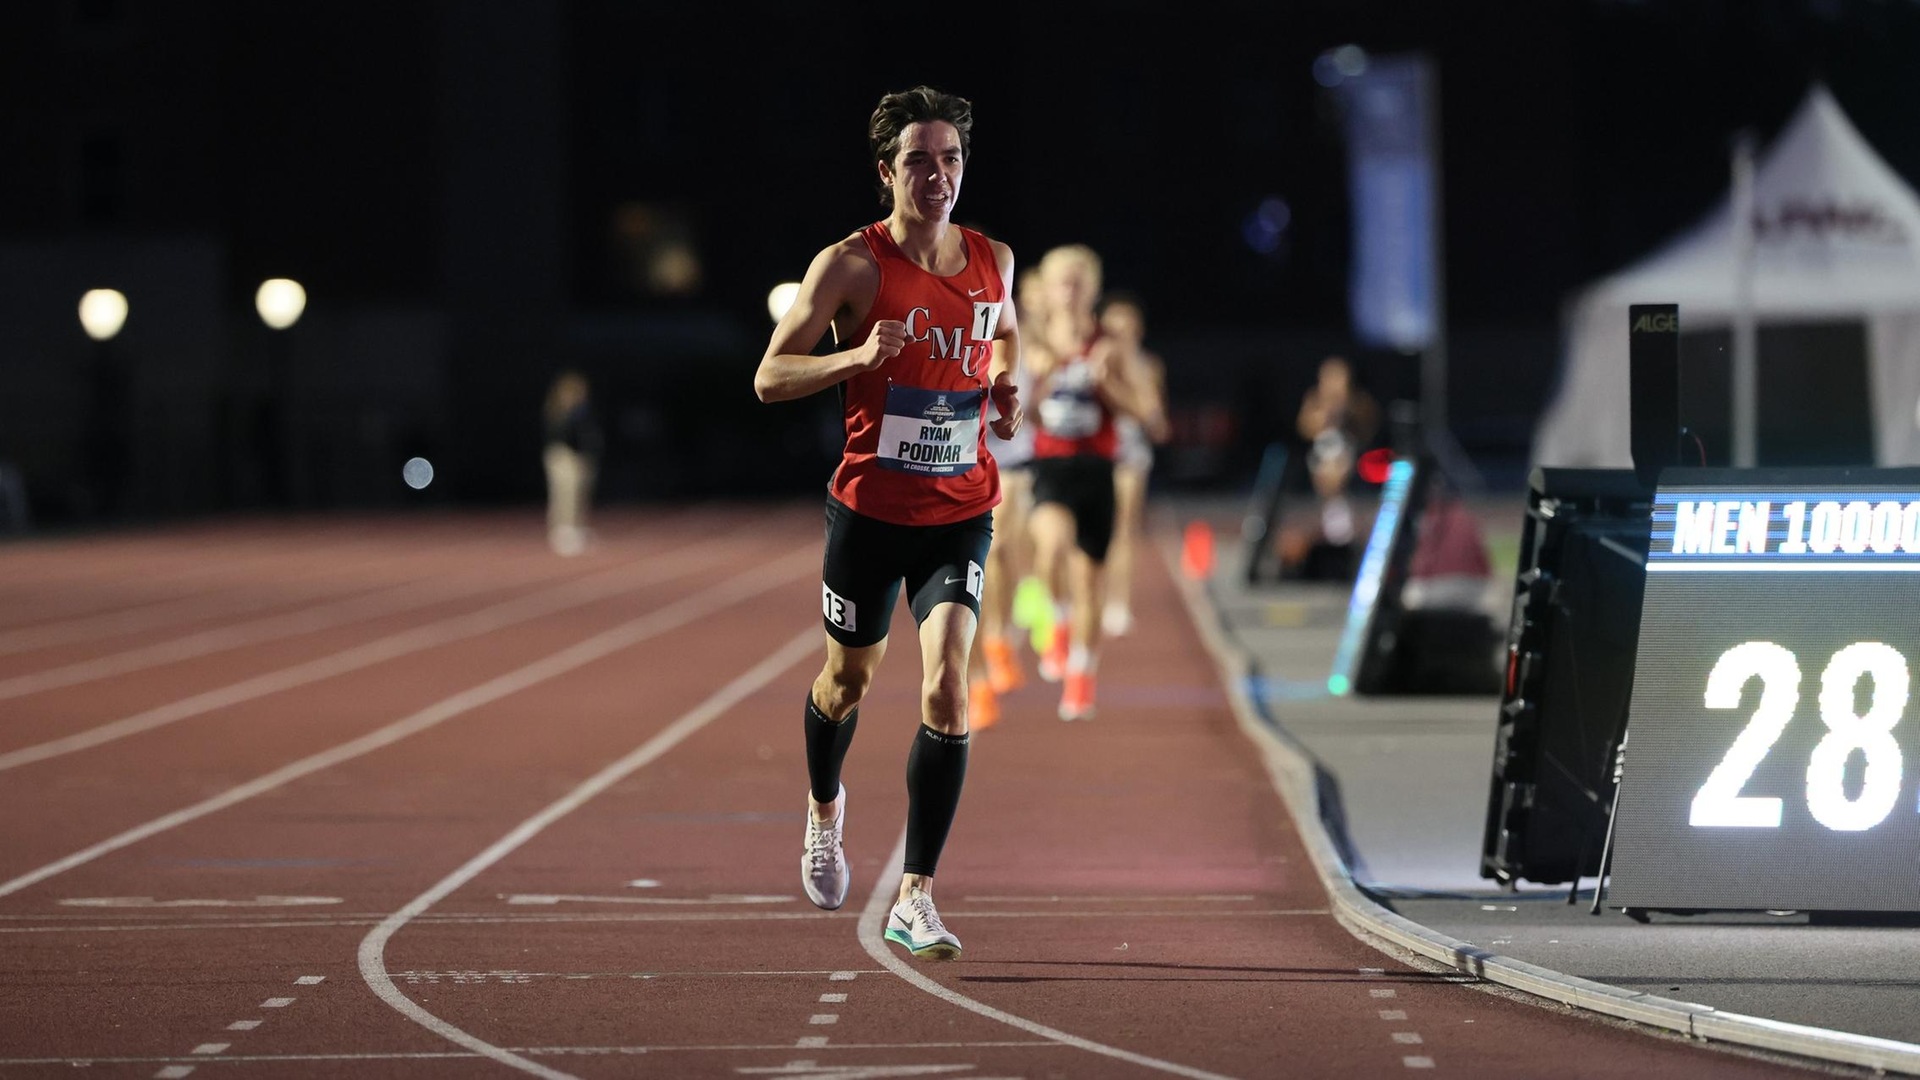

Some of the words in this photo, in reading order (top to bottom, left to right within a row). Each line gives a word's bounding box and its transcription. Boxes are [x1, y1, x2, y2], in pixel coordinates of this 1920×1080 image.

[1633, 314, 1677, 333] ALGE
[906, 307, 985, 377] CMU
[919, 426, 952, 442] RYAN
[897, 441, 961, 463] PODNAR
[1672, 500, 1770, 554] MEN
[825, 592, 847, 627] 13
[1689, 641, 1910, 831] 28
